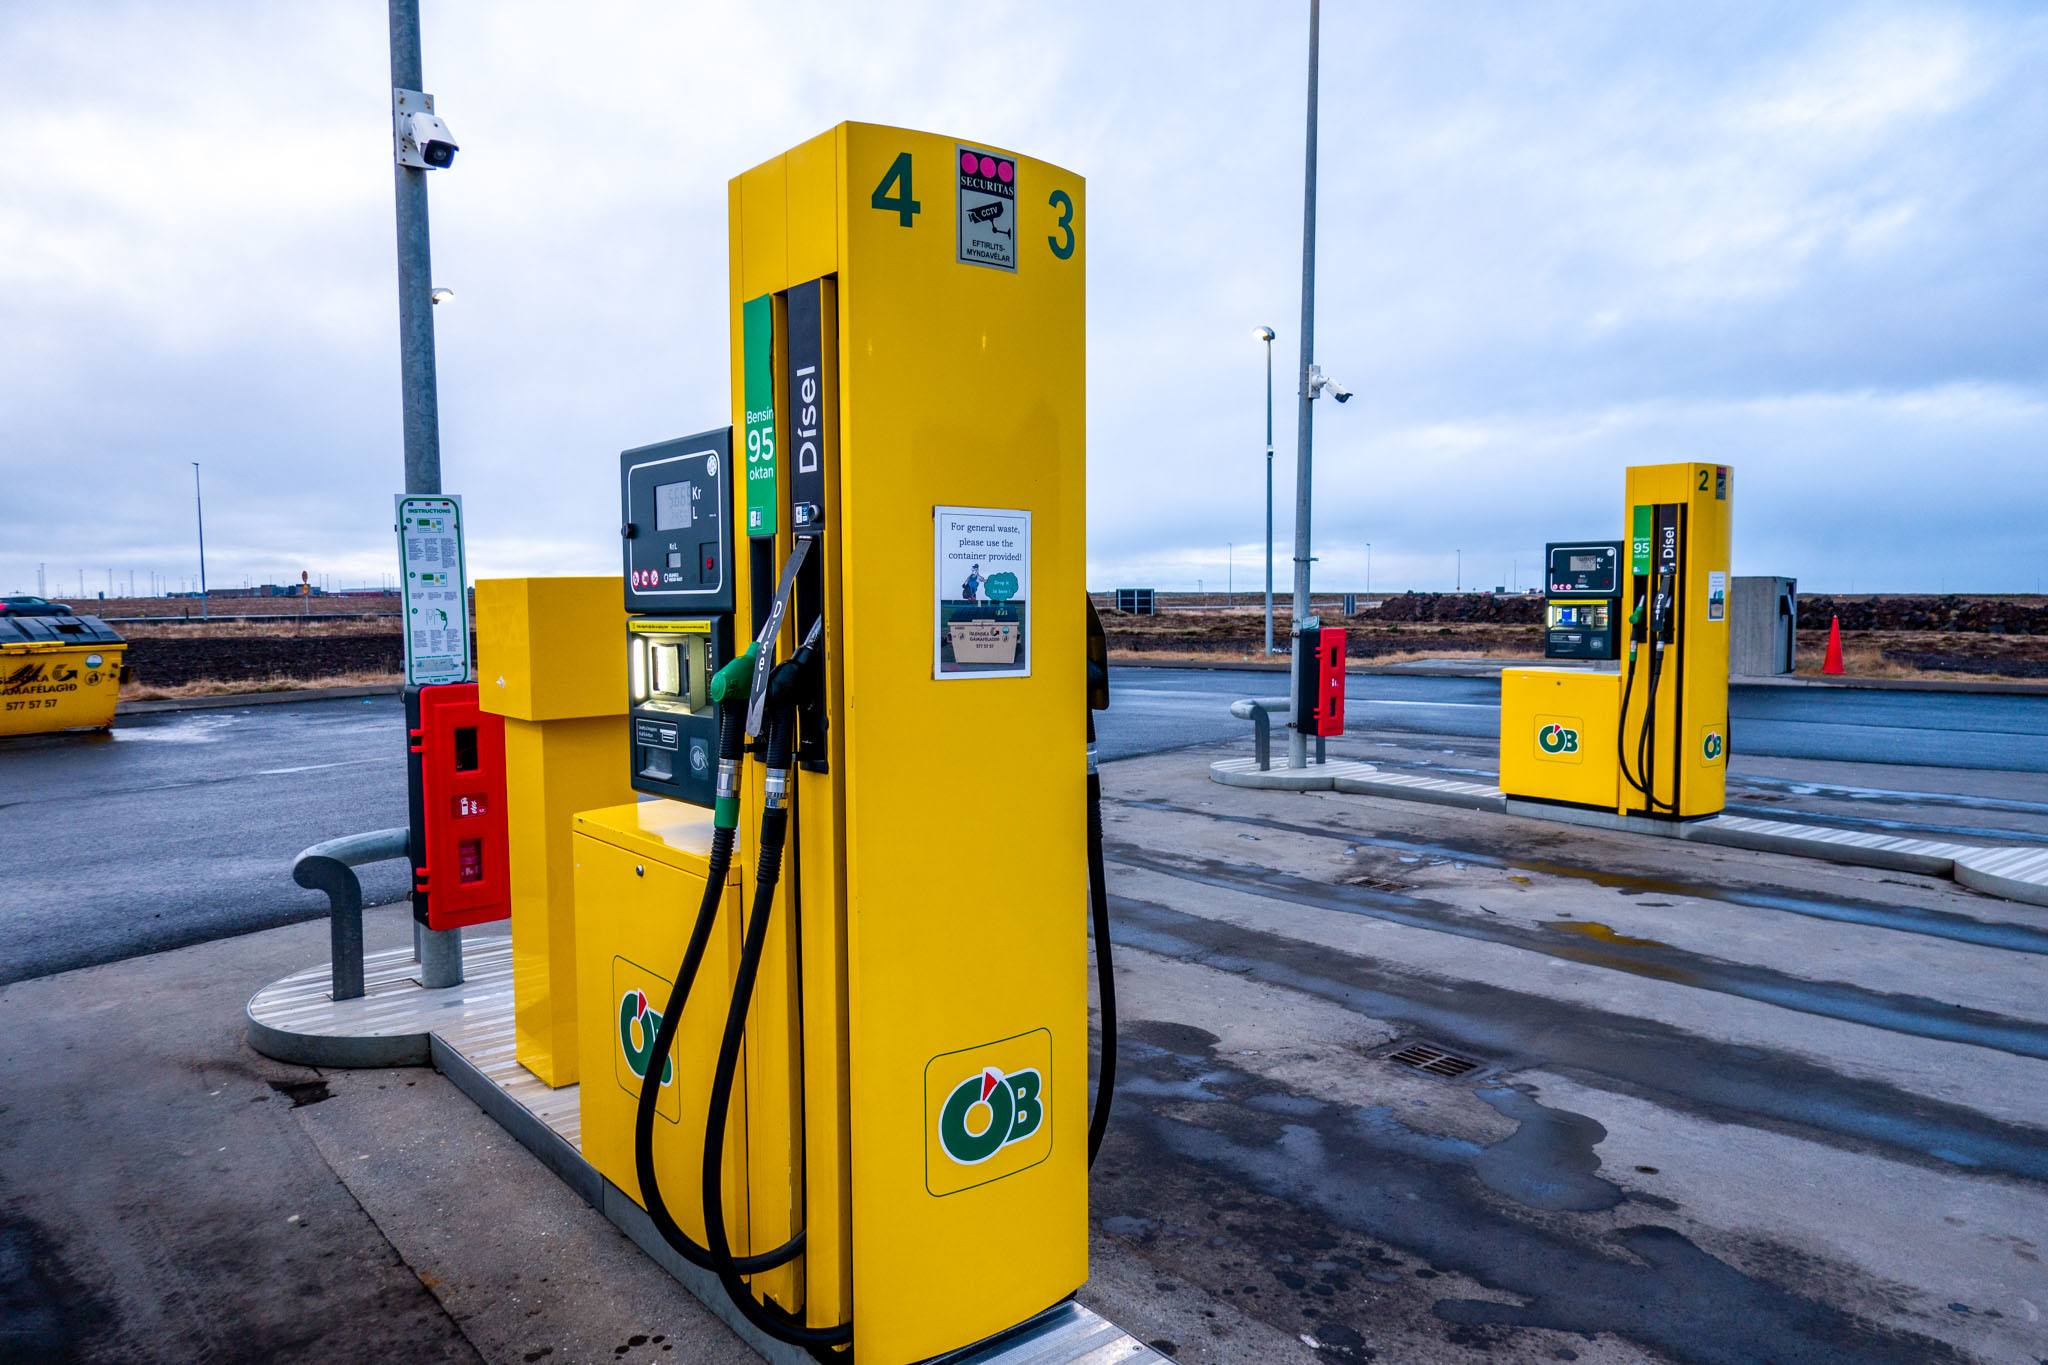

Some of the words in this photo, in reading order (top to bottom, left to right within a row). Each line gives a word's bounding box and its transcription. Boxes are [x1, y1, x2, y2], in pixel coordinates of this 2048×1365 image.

[871, 152, 921, 228] 4
[960, 175, 1014, 196] SECURITAS
[981, 206, 998, 218] CCTV
[1047, 189, 1075, 260] 3
[972, 239, 1005, 252] EFTIRLITS-
[967, 248, 1010, 262] MYNDAVÉLAR
[796, 365, 818, 474] Dísel
[748, 427, 774, 463] 95
[749, 467, 774, 481] oktan
[1698, 470, 1709, 491] 2
[692, 486, 701, 500] Kr
[692, 506, 698, 520] L
[951, 522, 965, 531] For
[967, 524, 996, 533] general
[997, 526, 1020, 534] waste,
[959, 538, 984, 547] please
[1001, 539, 1014, 547] the
[1633, 542, 1650, 554] 95
[948, 551, 987, 560] container
[988, 553, 1022, 562] provided!
[6, 701, 25, 711] 577
[28, 700, 41, 709] 57
[45, 699, 58, 708] 57
